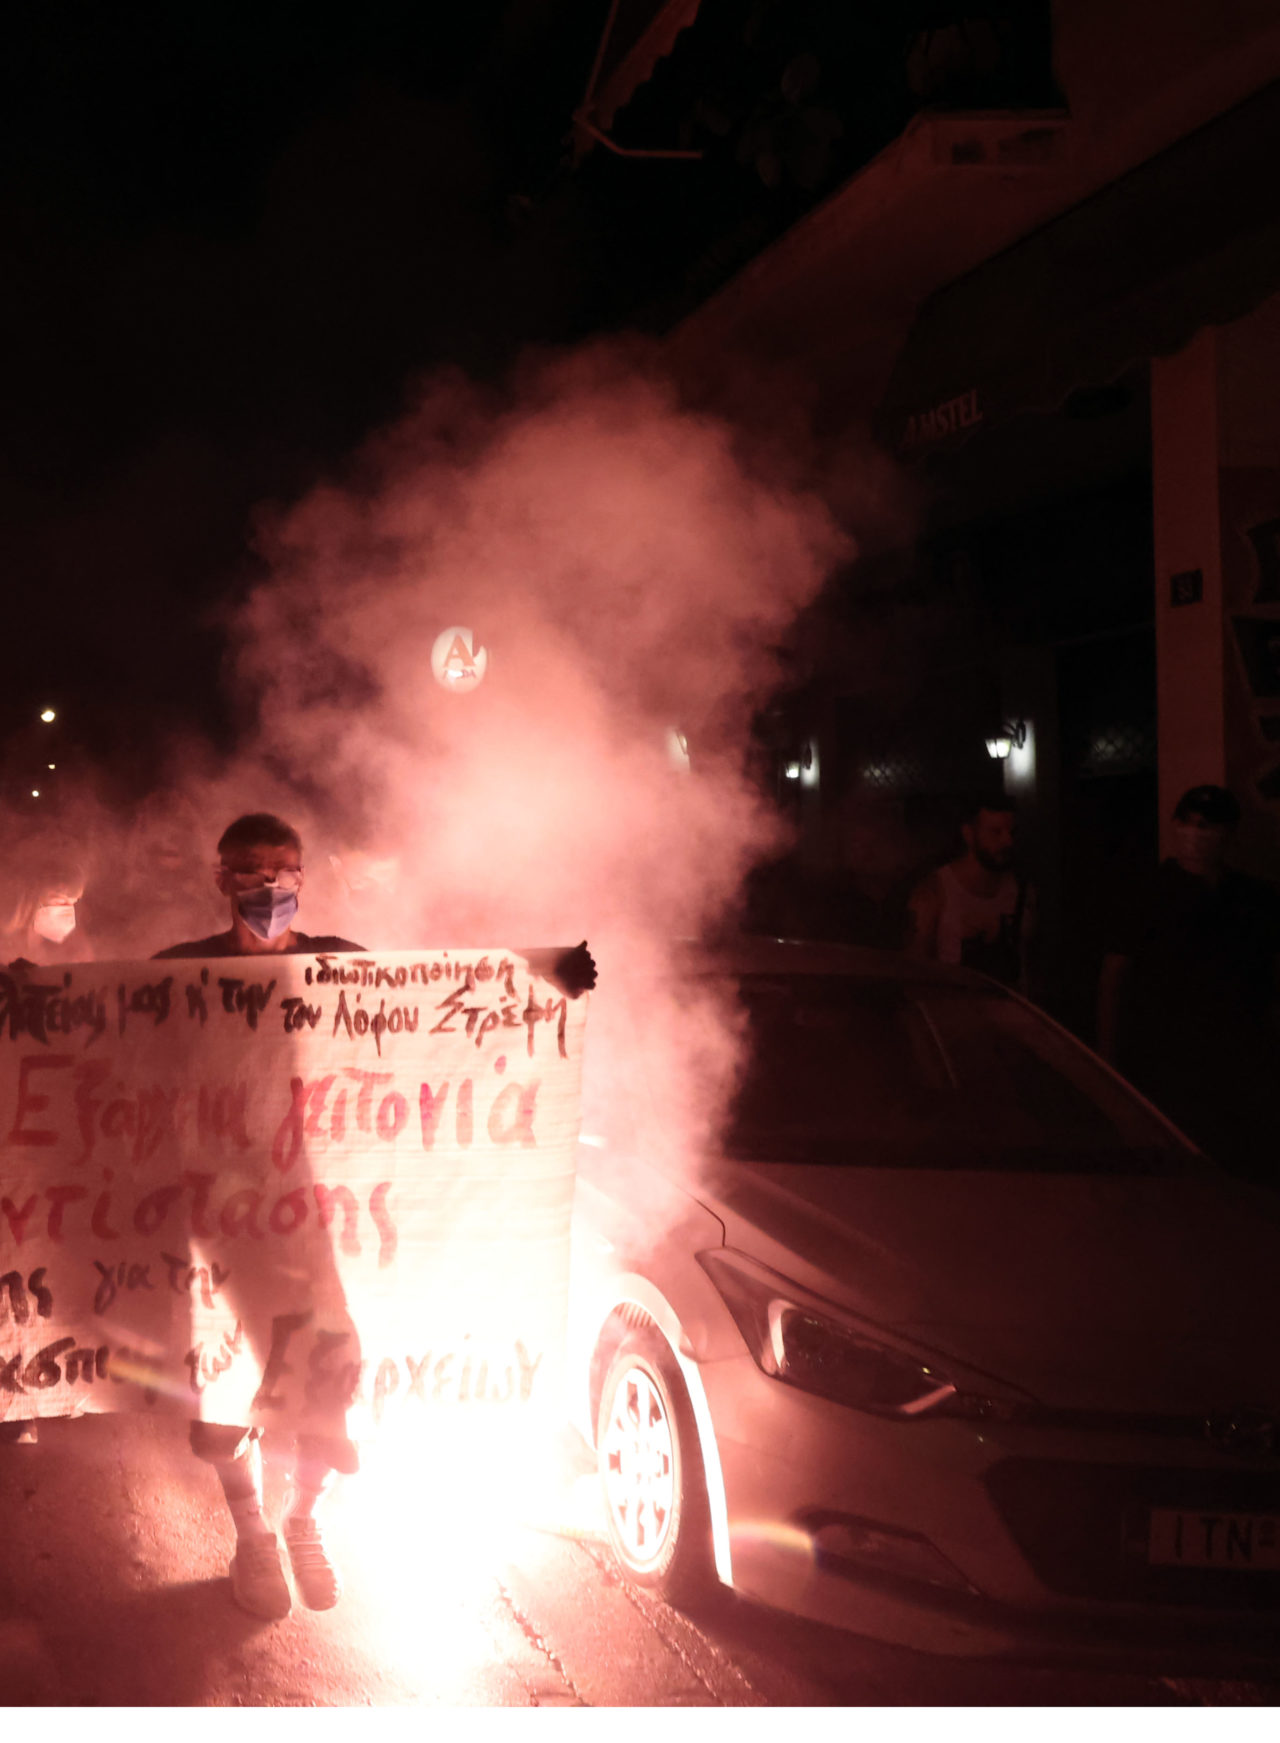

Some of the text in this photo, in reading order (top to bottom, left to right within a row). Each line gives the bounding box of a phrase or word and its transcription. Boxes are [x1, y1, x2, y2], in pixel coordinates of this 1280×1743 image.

[900, 388, 984, 447] AMSTEL
[117, 977, 174, 1038] μας
[218, 976, 277, 1032] την
[305, 951, 521, 1002] ιδιωτικοποίηση
[332, 990, 420, 1058] Λόφου
[428, 984, 570, 1060] Στρέφη
[8, 1053, 252, 1167] Εξάρχια
[270, 1054, 542, 1174] γειτονιά
[93, 1260, 156, 1315] για
[160, 1251, 232, 1309] την
